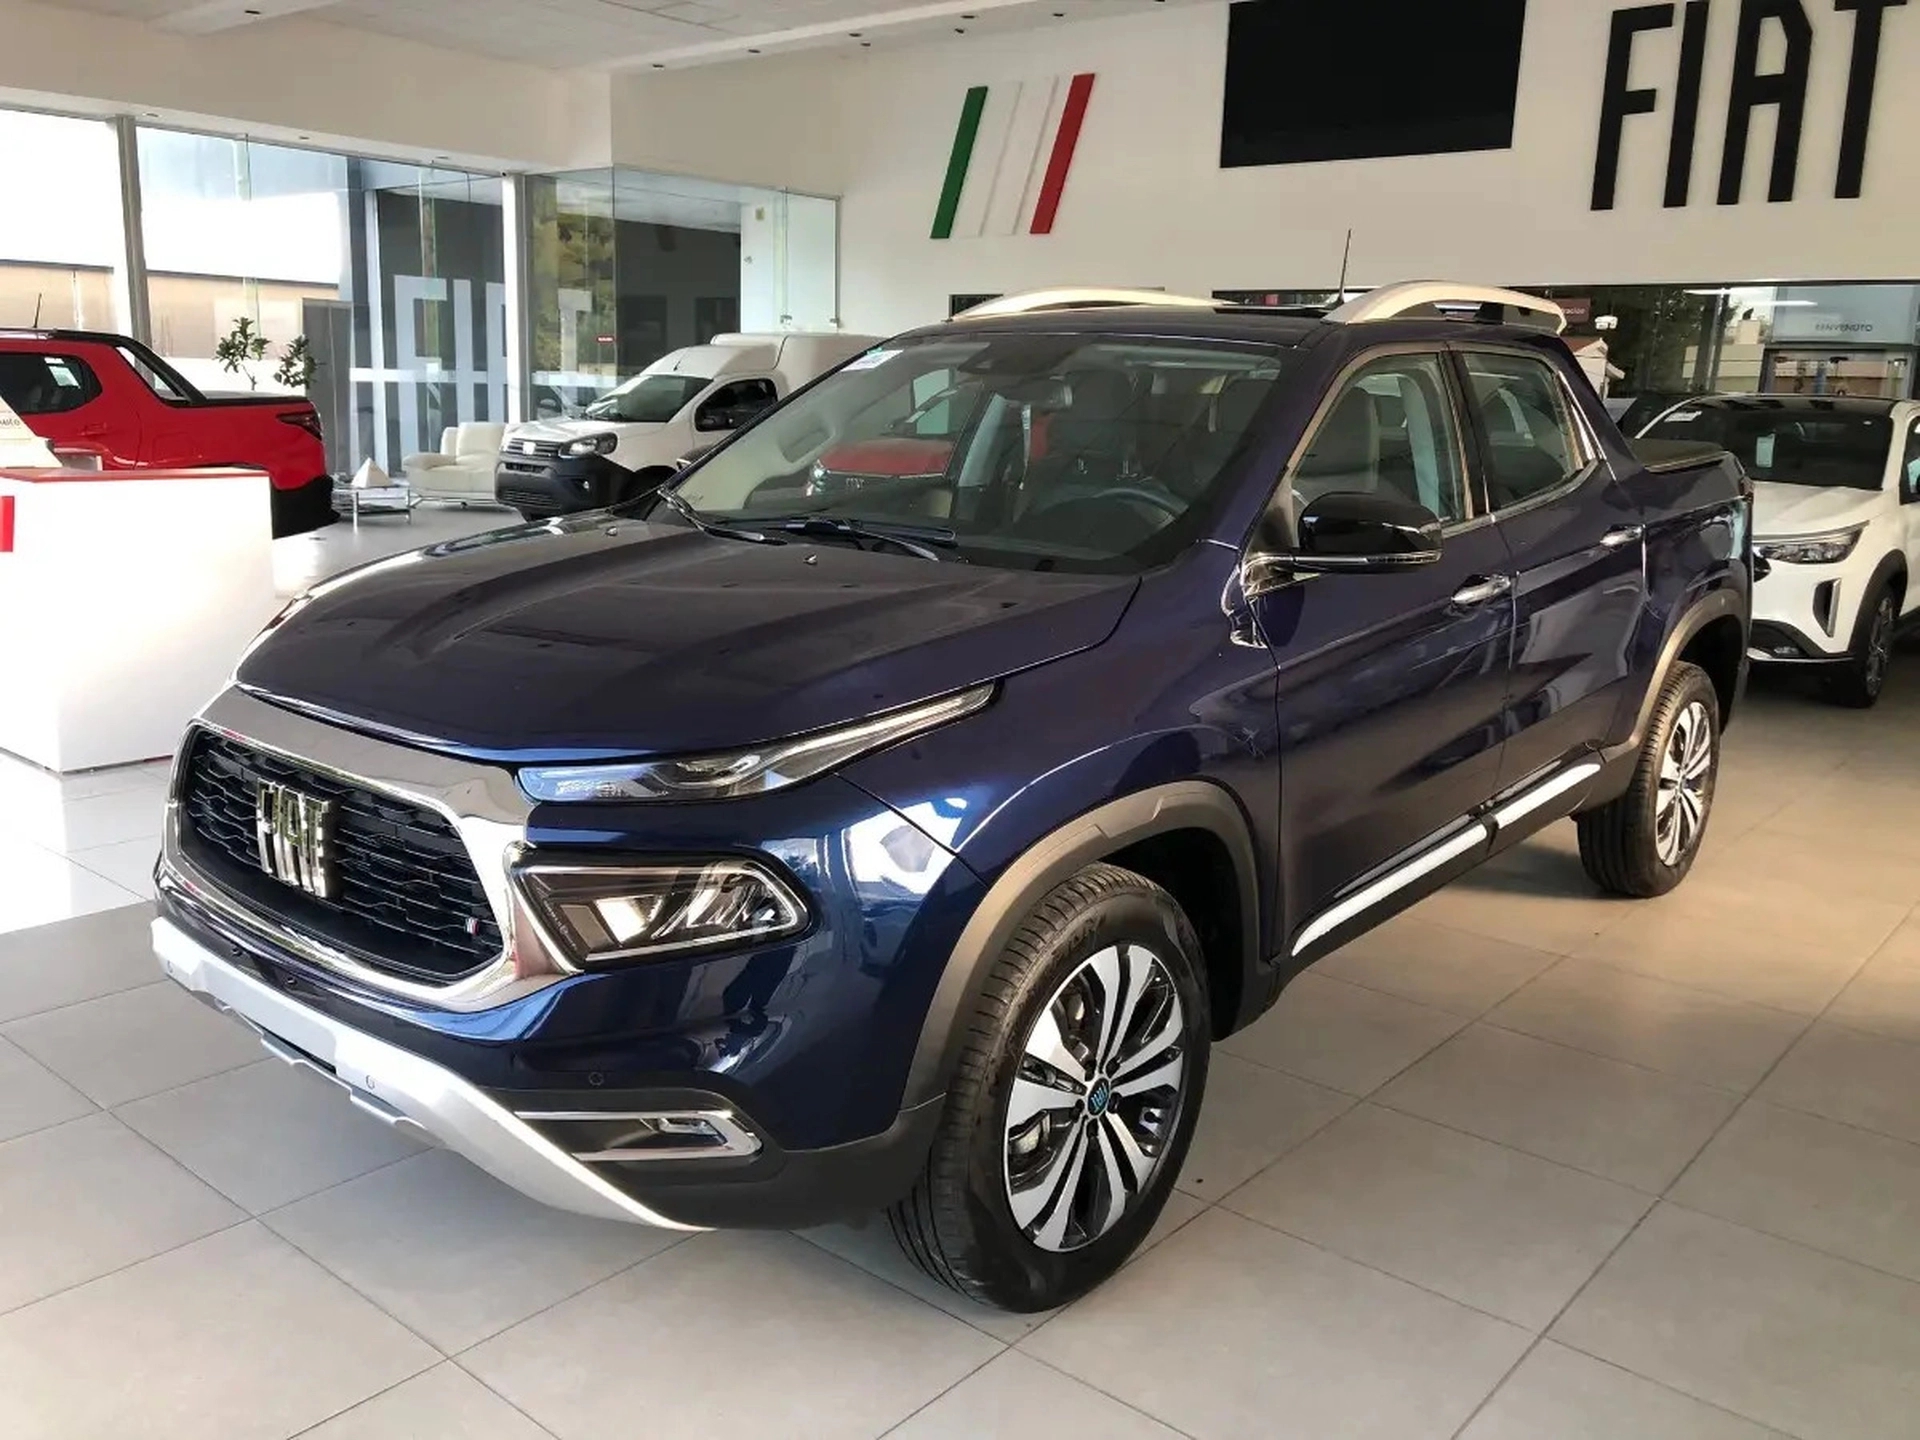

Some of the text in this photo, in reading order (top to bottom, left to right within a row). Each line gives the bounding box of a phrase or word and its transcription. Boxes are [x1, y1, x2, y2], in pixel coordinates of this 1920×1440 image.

[1590, 0, 1909, 210] FIAT
[394, 275, 592, 460] FIT
[256, 777, 329, 898] FIAT
